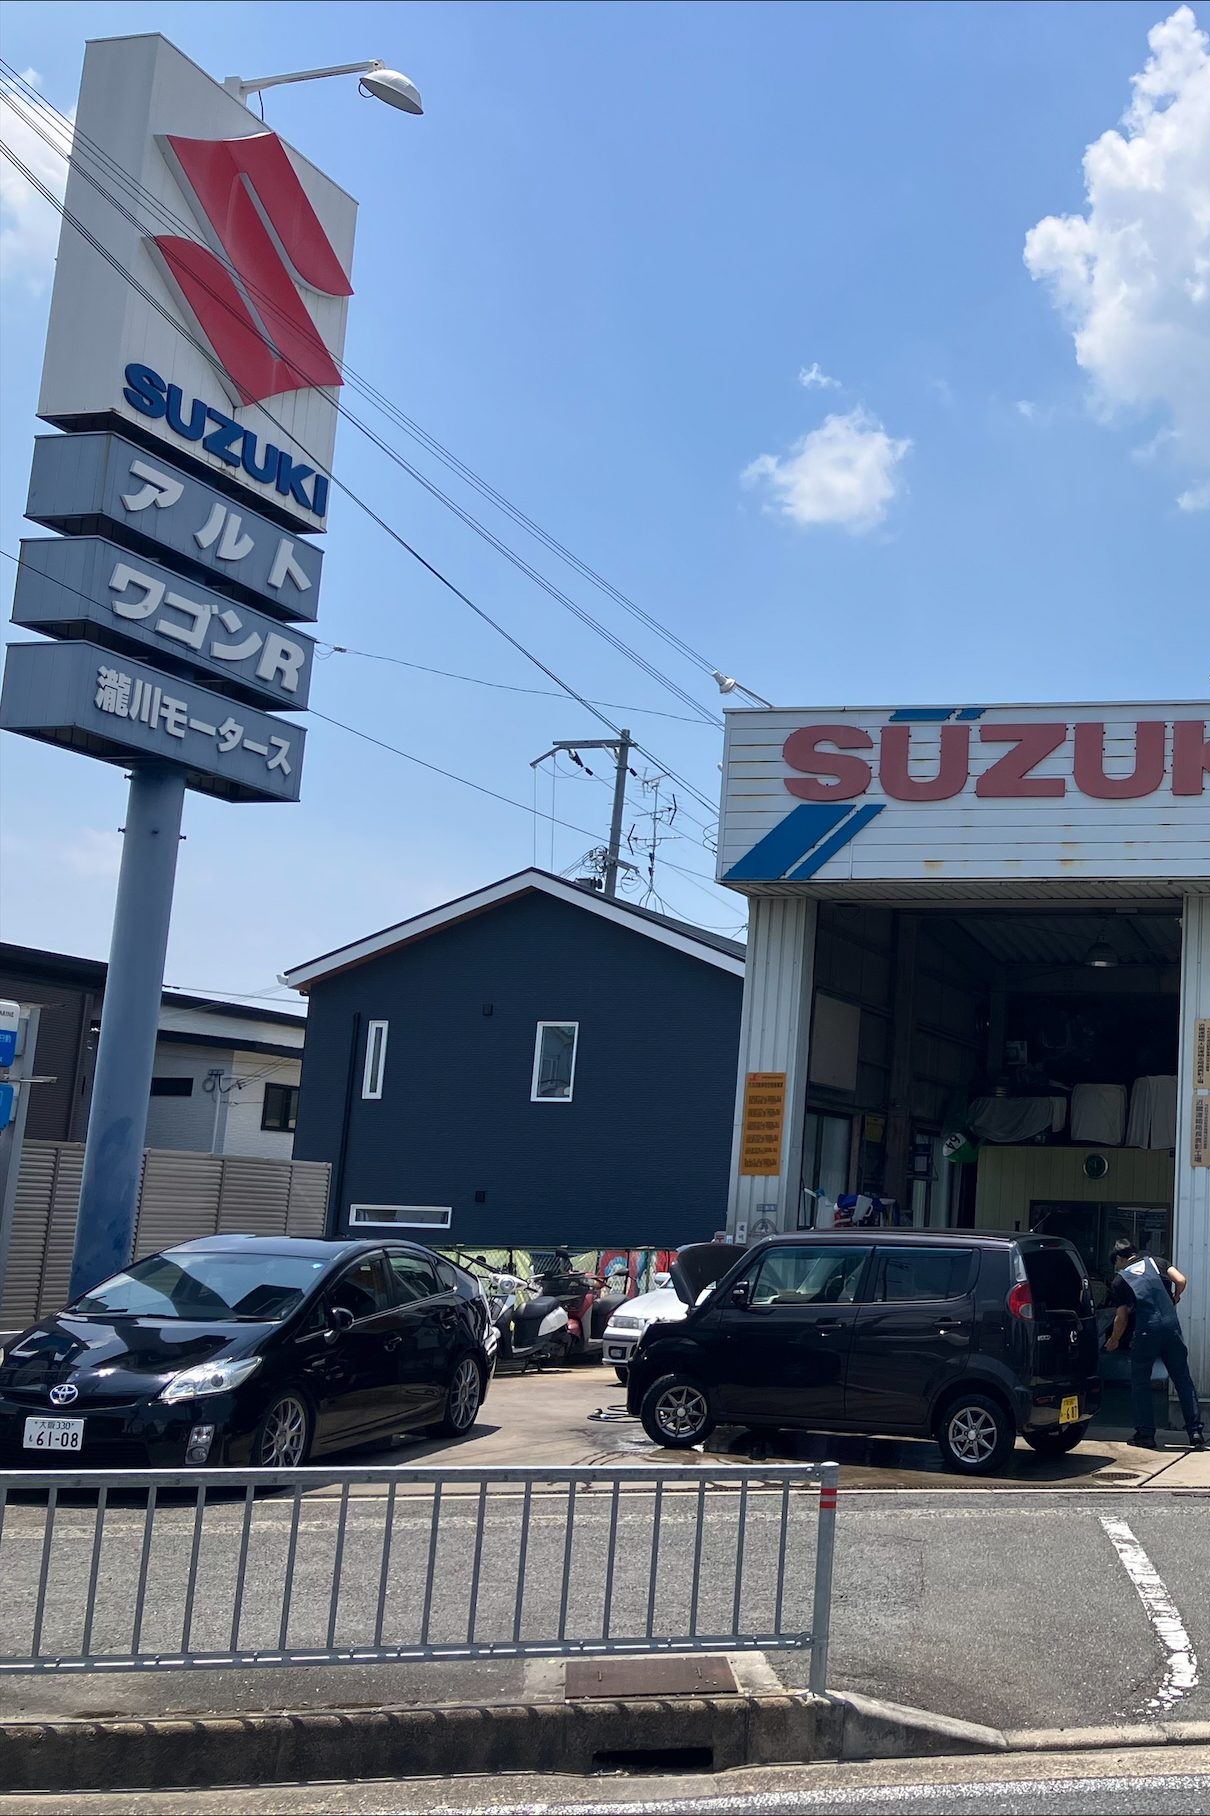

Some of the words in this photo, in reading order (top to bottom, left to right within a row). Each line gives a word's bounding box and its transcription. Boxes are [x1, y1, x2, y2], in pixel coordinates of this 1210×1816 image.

[122, 363, 329, 518] SUZUKI
[120, 459, 312, 592] アルト
[108, 562, 305, 693] ワゴンR
[94, 665, 292, 775] 瀧川モータース
[36, 1431, 79, 1448] 61-08
